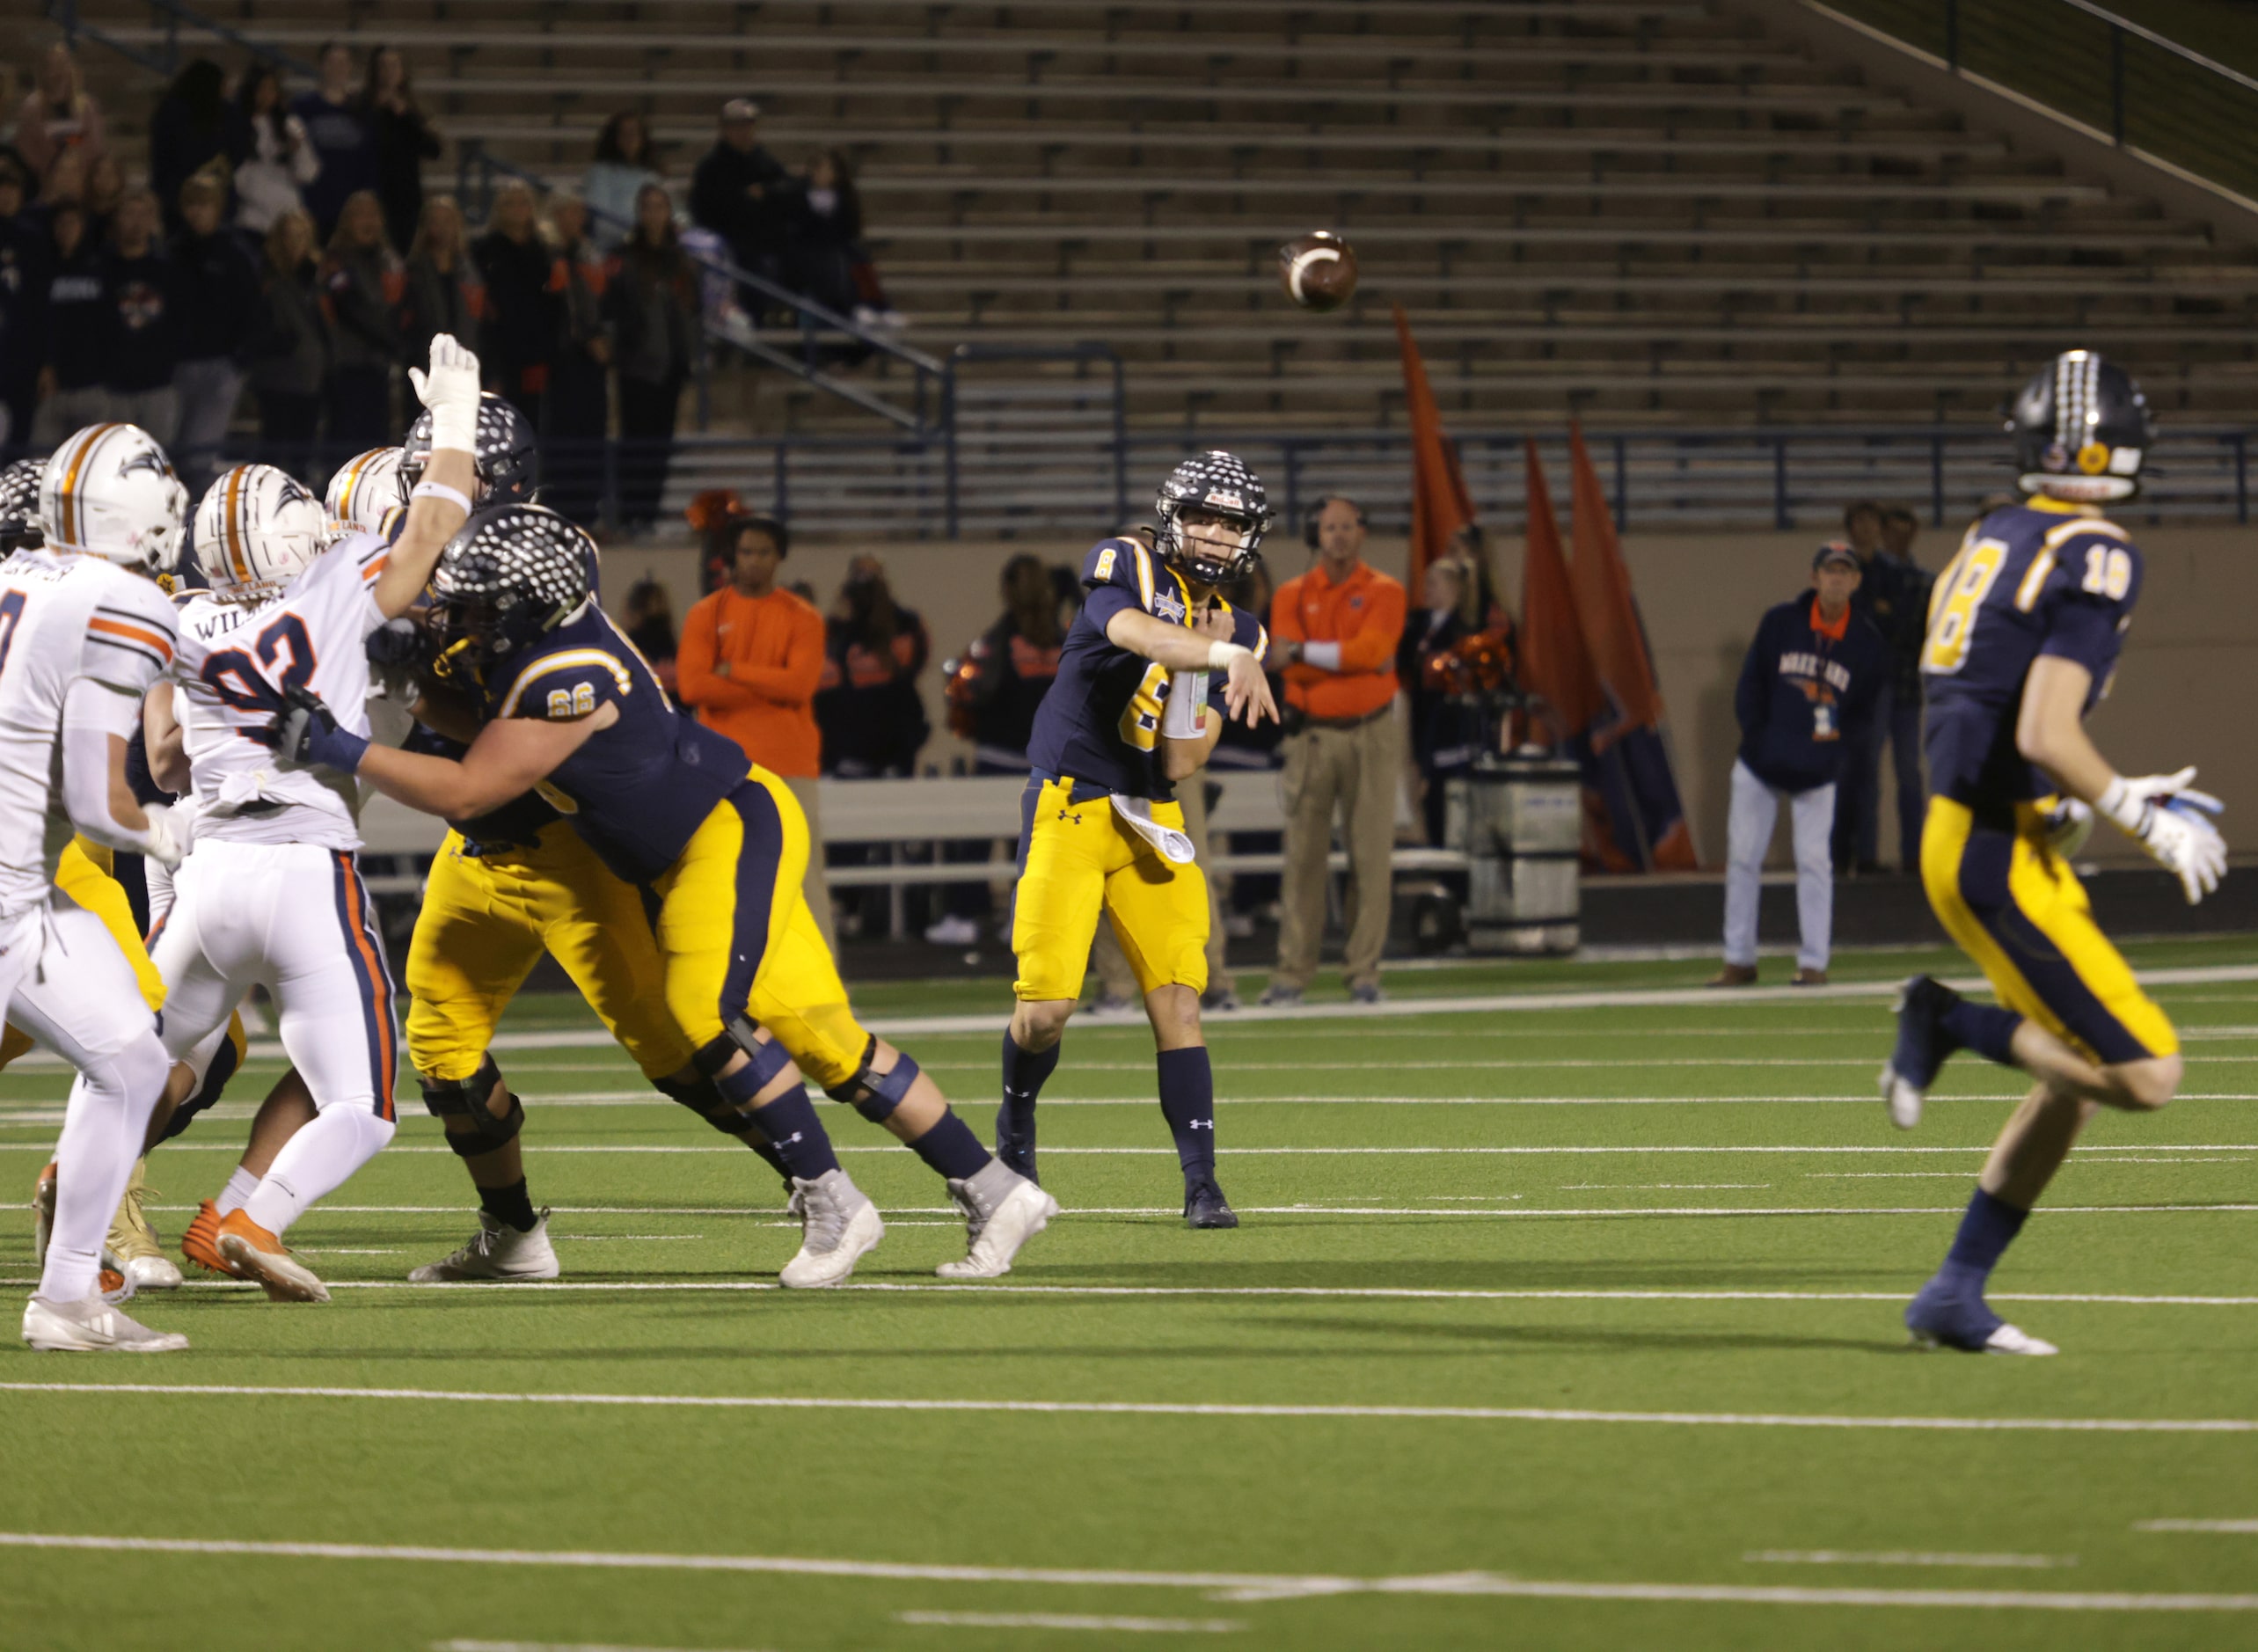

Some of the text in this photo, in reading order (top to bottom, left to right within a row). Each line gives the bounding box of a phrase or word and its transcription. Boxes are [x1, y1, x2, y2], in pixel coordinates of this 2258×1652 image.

[1093, 548, 1116, 582] 8
[2081, 543, 2132, 602] 18
[547, 681, 596, 717] 66
